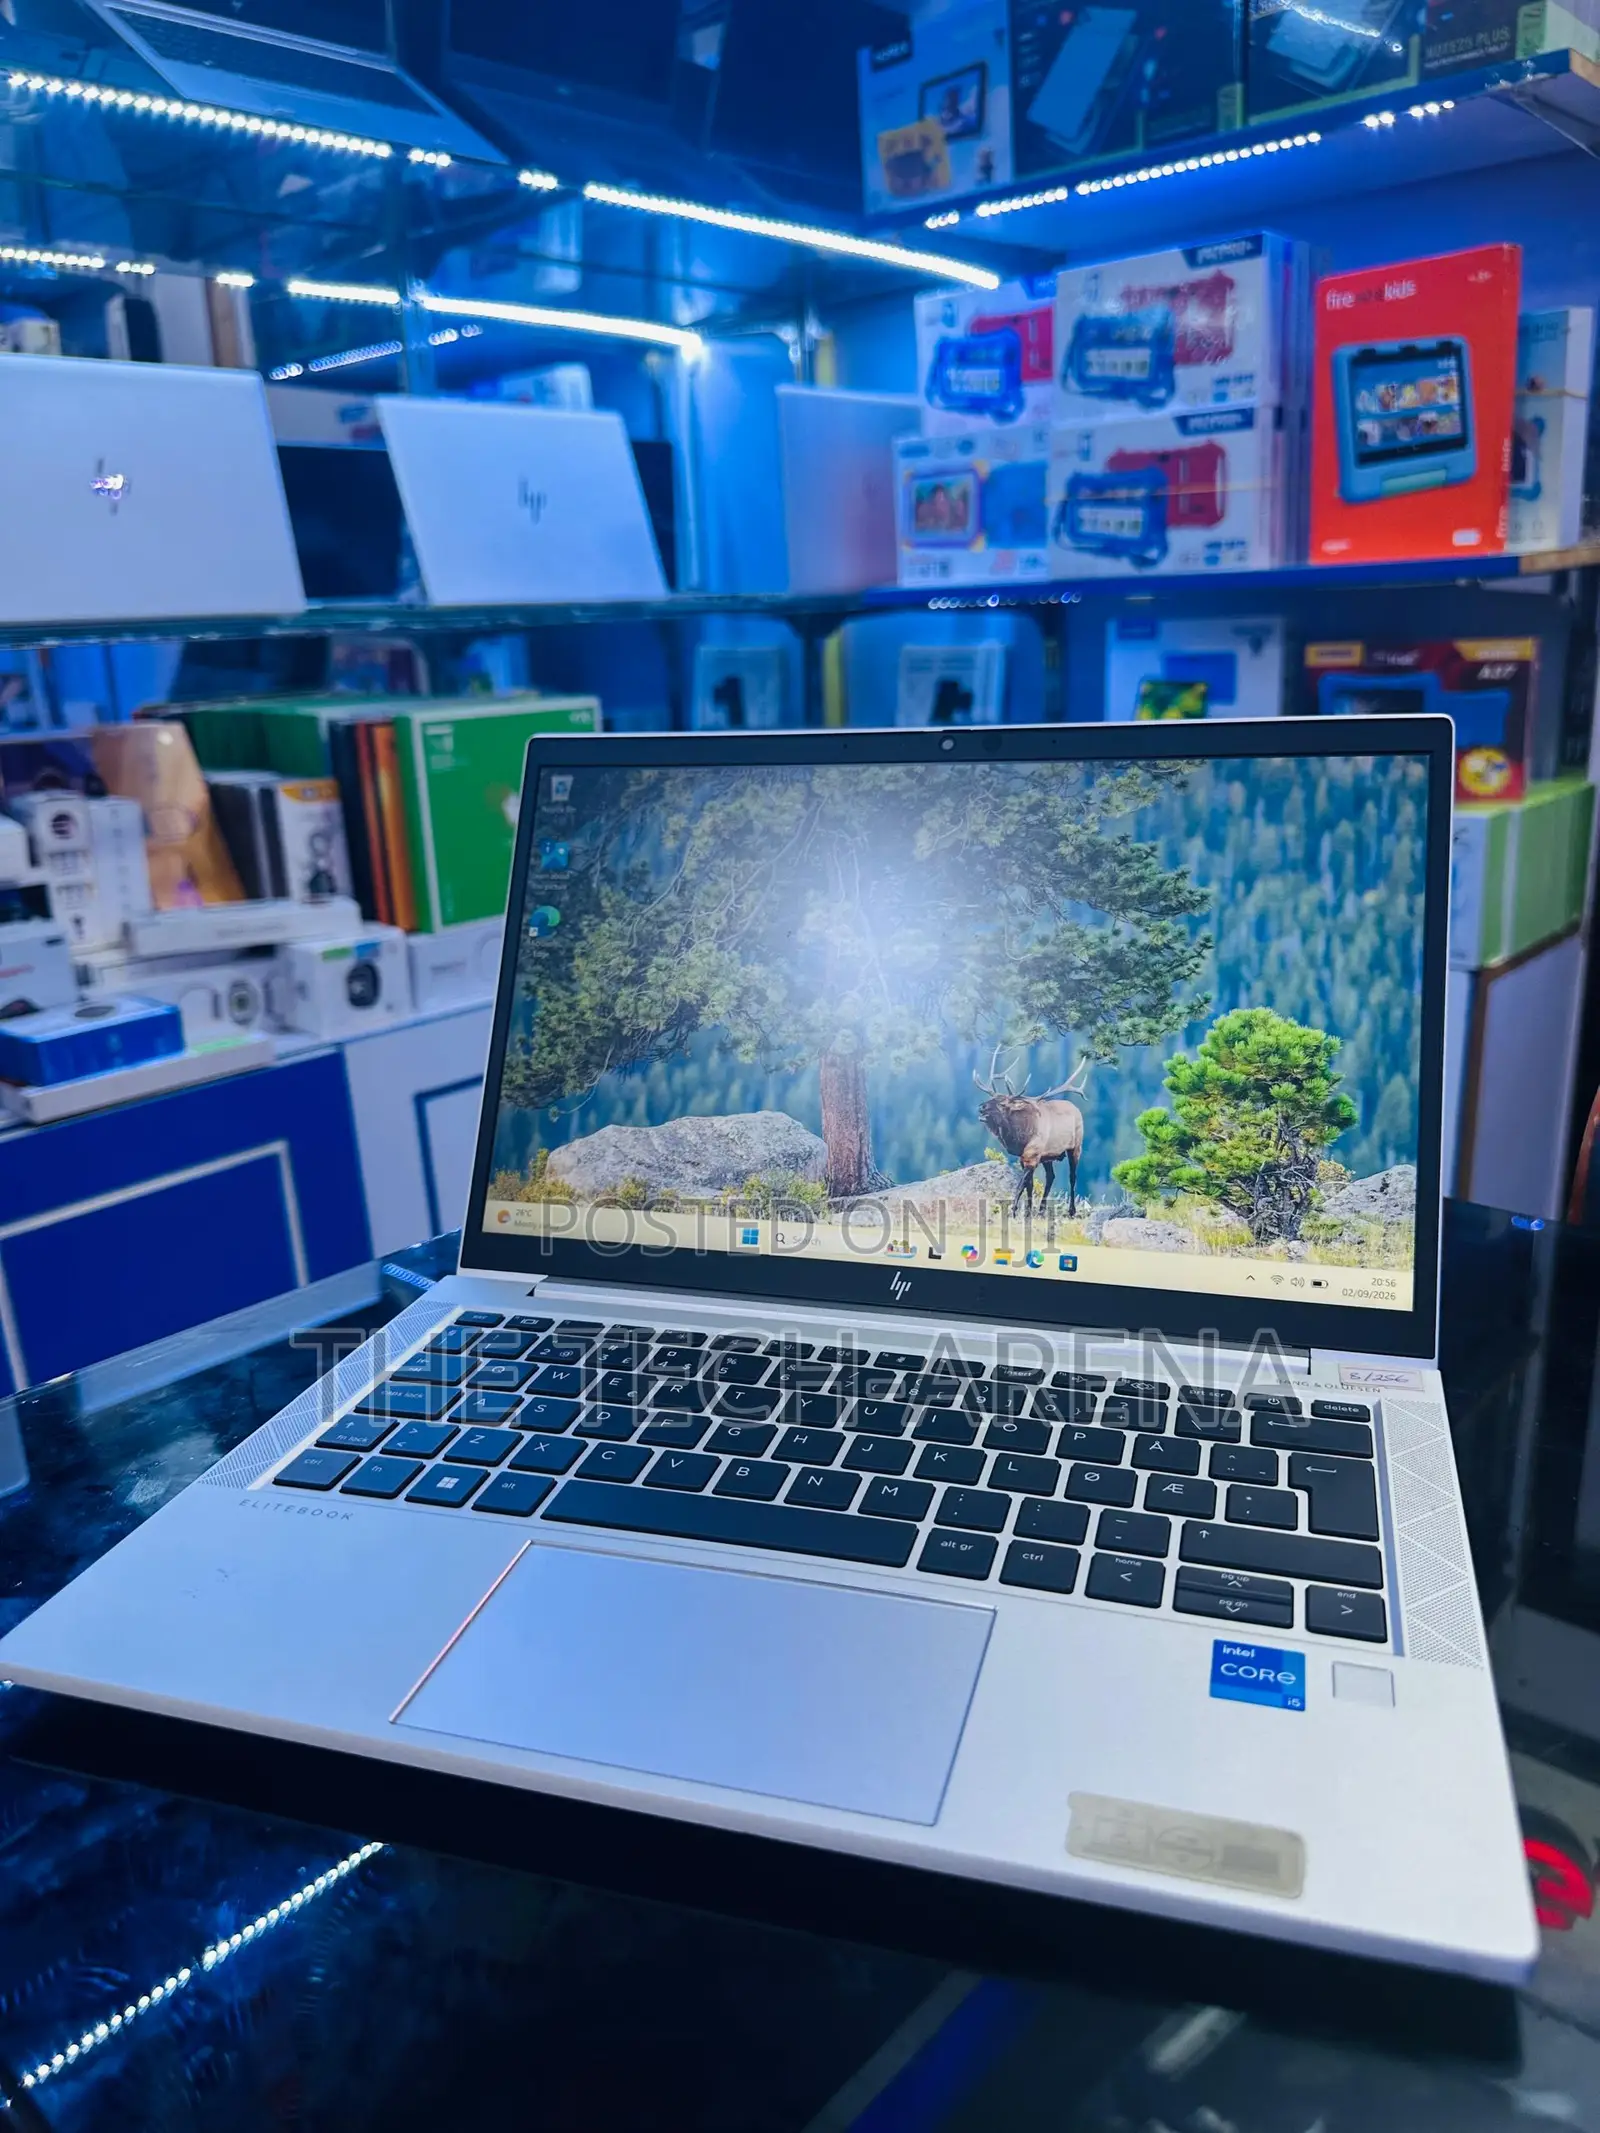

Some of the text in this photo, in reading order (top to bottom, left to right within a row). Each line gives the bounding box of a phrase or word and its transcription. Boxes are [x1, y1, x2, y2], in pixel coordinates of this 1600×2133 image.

[890, 1271, 912, 1301] hp
[1371, 1277, 1397, 1288] 20:56
[1341, 1288, 1397, 1301] 02/09/2026
[539, 1348, 551, 1356] 2
[598, 1353, 610, 1361] 3
[726, 1357, 737, 1365] %
[491, 1365, 506, 1374] Q
[552, 1371, 571, 1380] W
[608, 1377, 623, 1386] E
[669, 1384, 684, 1393] R
[735, 1391, 746, 1400] T
[472, 1397, 487, 1407] A
[801, 1398, 813, 1408] Y
[534, 1404, 548, 1413] S
[863, 1406, 878, 1416] U
[1323, 1403, 1360, 1413] delete
[596, 1411, 611, 1420] D
[660, 1418, 674, 1427] F
[727, 1427, 742, 1436] G
[1073, 1432, 1087, 1441] P
[352, 1435, 369, 1443] lock
[469, 1434, 485, 1444] Z
[793, 1434, 808, 1444] H
[534, 1442, 550, 1452] X
[861, 1443, 874, 1452] J
[1149, 1440, 1164, 1452] Å
[601, 1450, 616, 1460] C
[933, 1451, 948, 1462] K
[304, 1458, 323, 1466] ctrl
[671, 1458, 684, 1468] V
[1007, 1461, 1019, 1472] L
[371, 1465, 383, 1473] fn
[736, 1466, 750, 1476] B
[807, 1475, 824, 1486] N
[501, 1482, 516, 1490] alt
[881, 1485, 899, 1496] M
[1162, 1483, 1185, 1495] Æ
[238, 1499, 354, 1521] ELITEBOOK
[940, 1540, 975, 1552] alt gr
[1022, 1552, 1044, 1562] ctrl
[1115, 1557, 1142, 1567] home
[1220, 1572, 1234, 1582] pg
[1337, 1590, 1357, 1600] end
[1222, 1644, 1256, 1658] intel
[1287, 1697, 1301, 1708] i5
